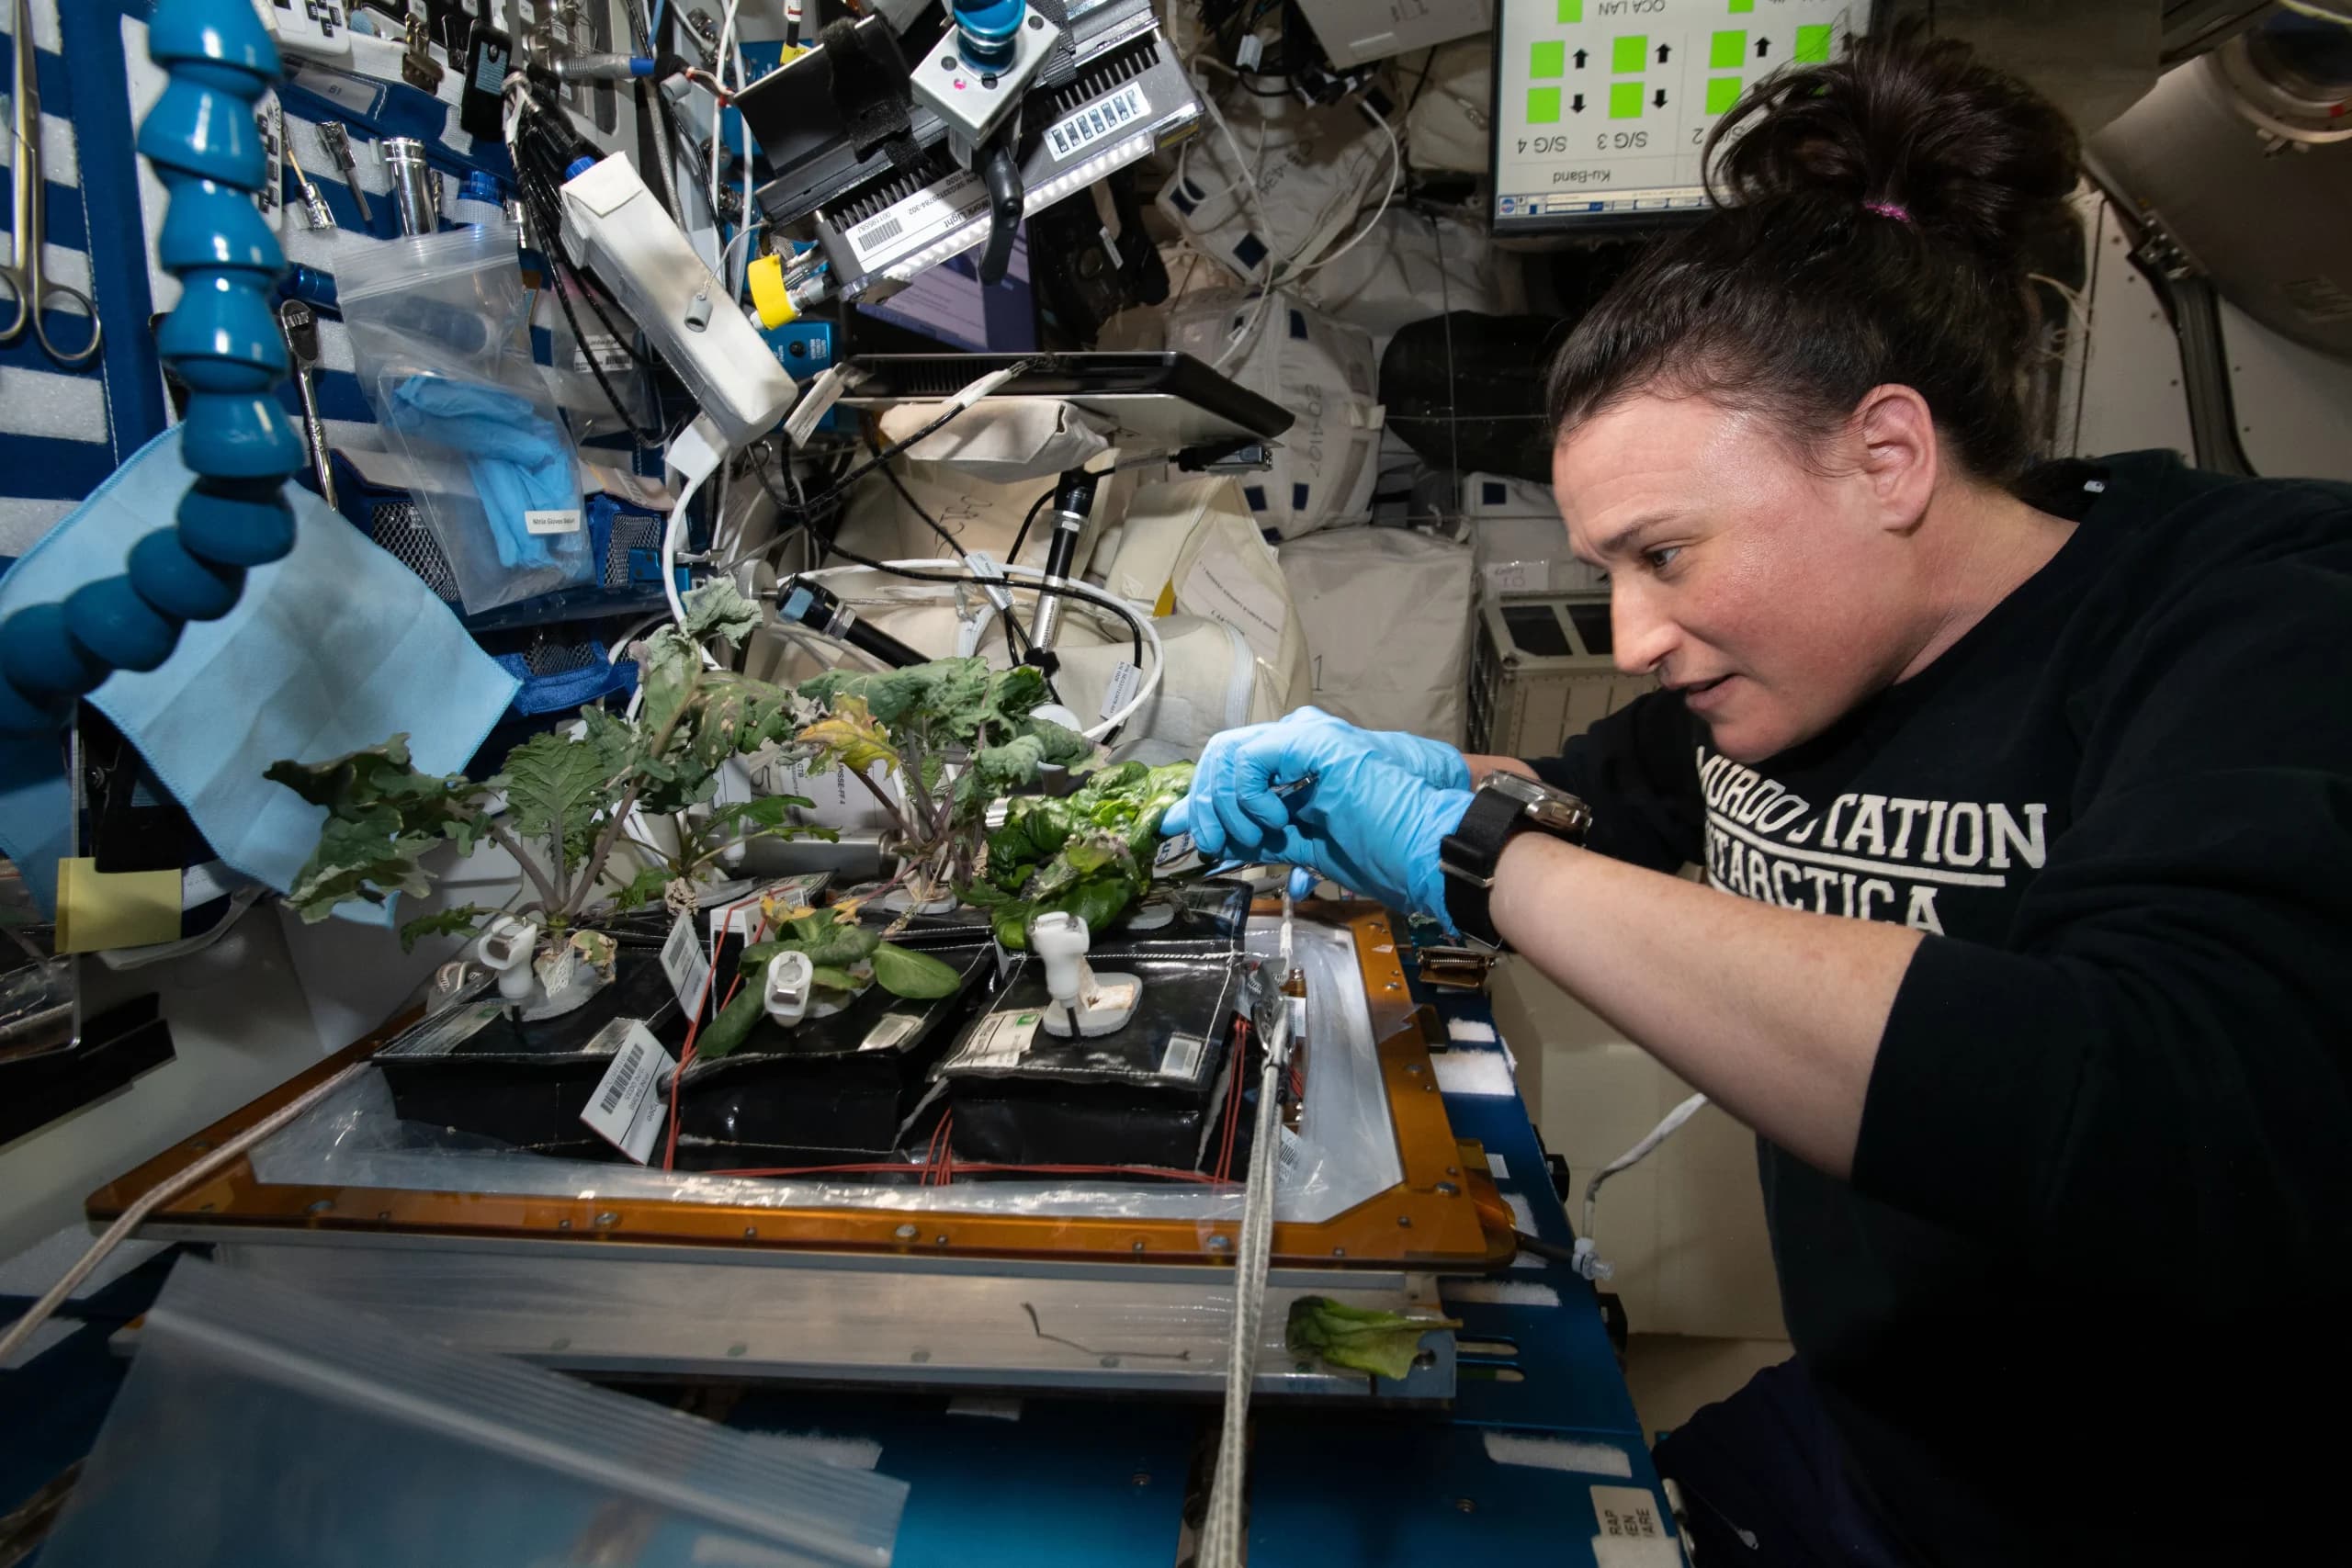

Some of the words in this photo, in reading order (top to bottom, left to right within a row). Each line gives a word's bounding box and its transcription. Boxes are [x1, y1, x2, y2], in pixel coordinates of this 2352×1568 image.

[1599, 1, 1628, 15] LAN
[1534, 135, 1567, 154] S/G
[1597, 132, 1609, 151] 3
[1614, 130, 1648, 150] S/G
[1691, 127, 1703, 145] 2
[1518, 138, 1528, 154] 4
[1553, 168, 1611, 185] Ku-Band
[944, 210, 968, 229] Light
